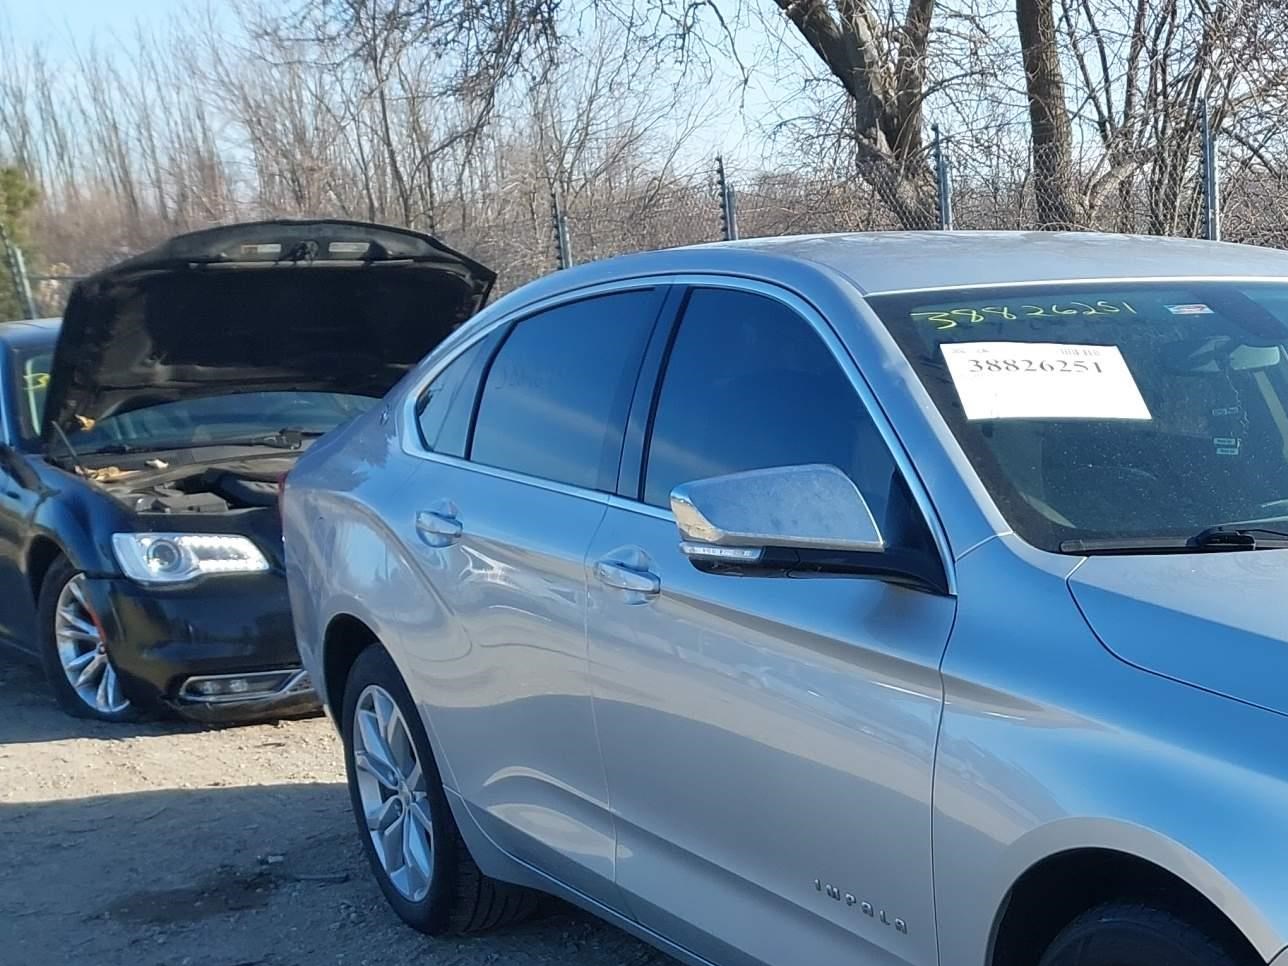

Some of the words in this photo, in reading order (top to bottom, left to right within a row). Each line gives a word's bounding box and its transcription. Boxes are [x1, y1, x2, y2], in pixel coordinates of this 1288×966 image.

[910, 301, 1137, 330] 38826251
[968, 359, 1103, 374] 38826251
[814, 879, 907, 934] IMPALA
